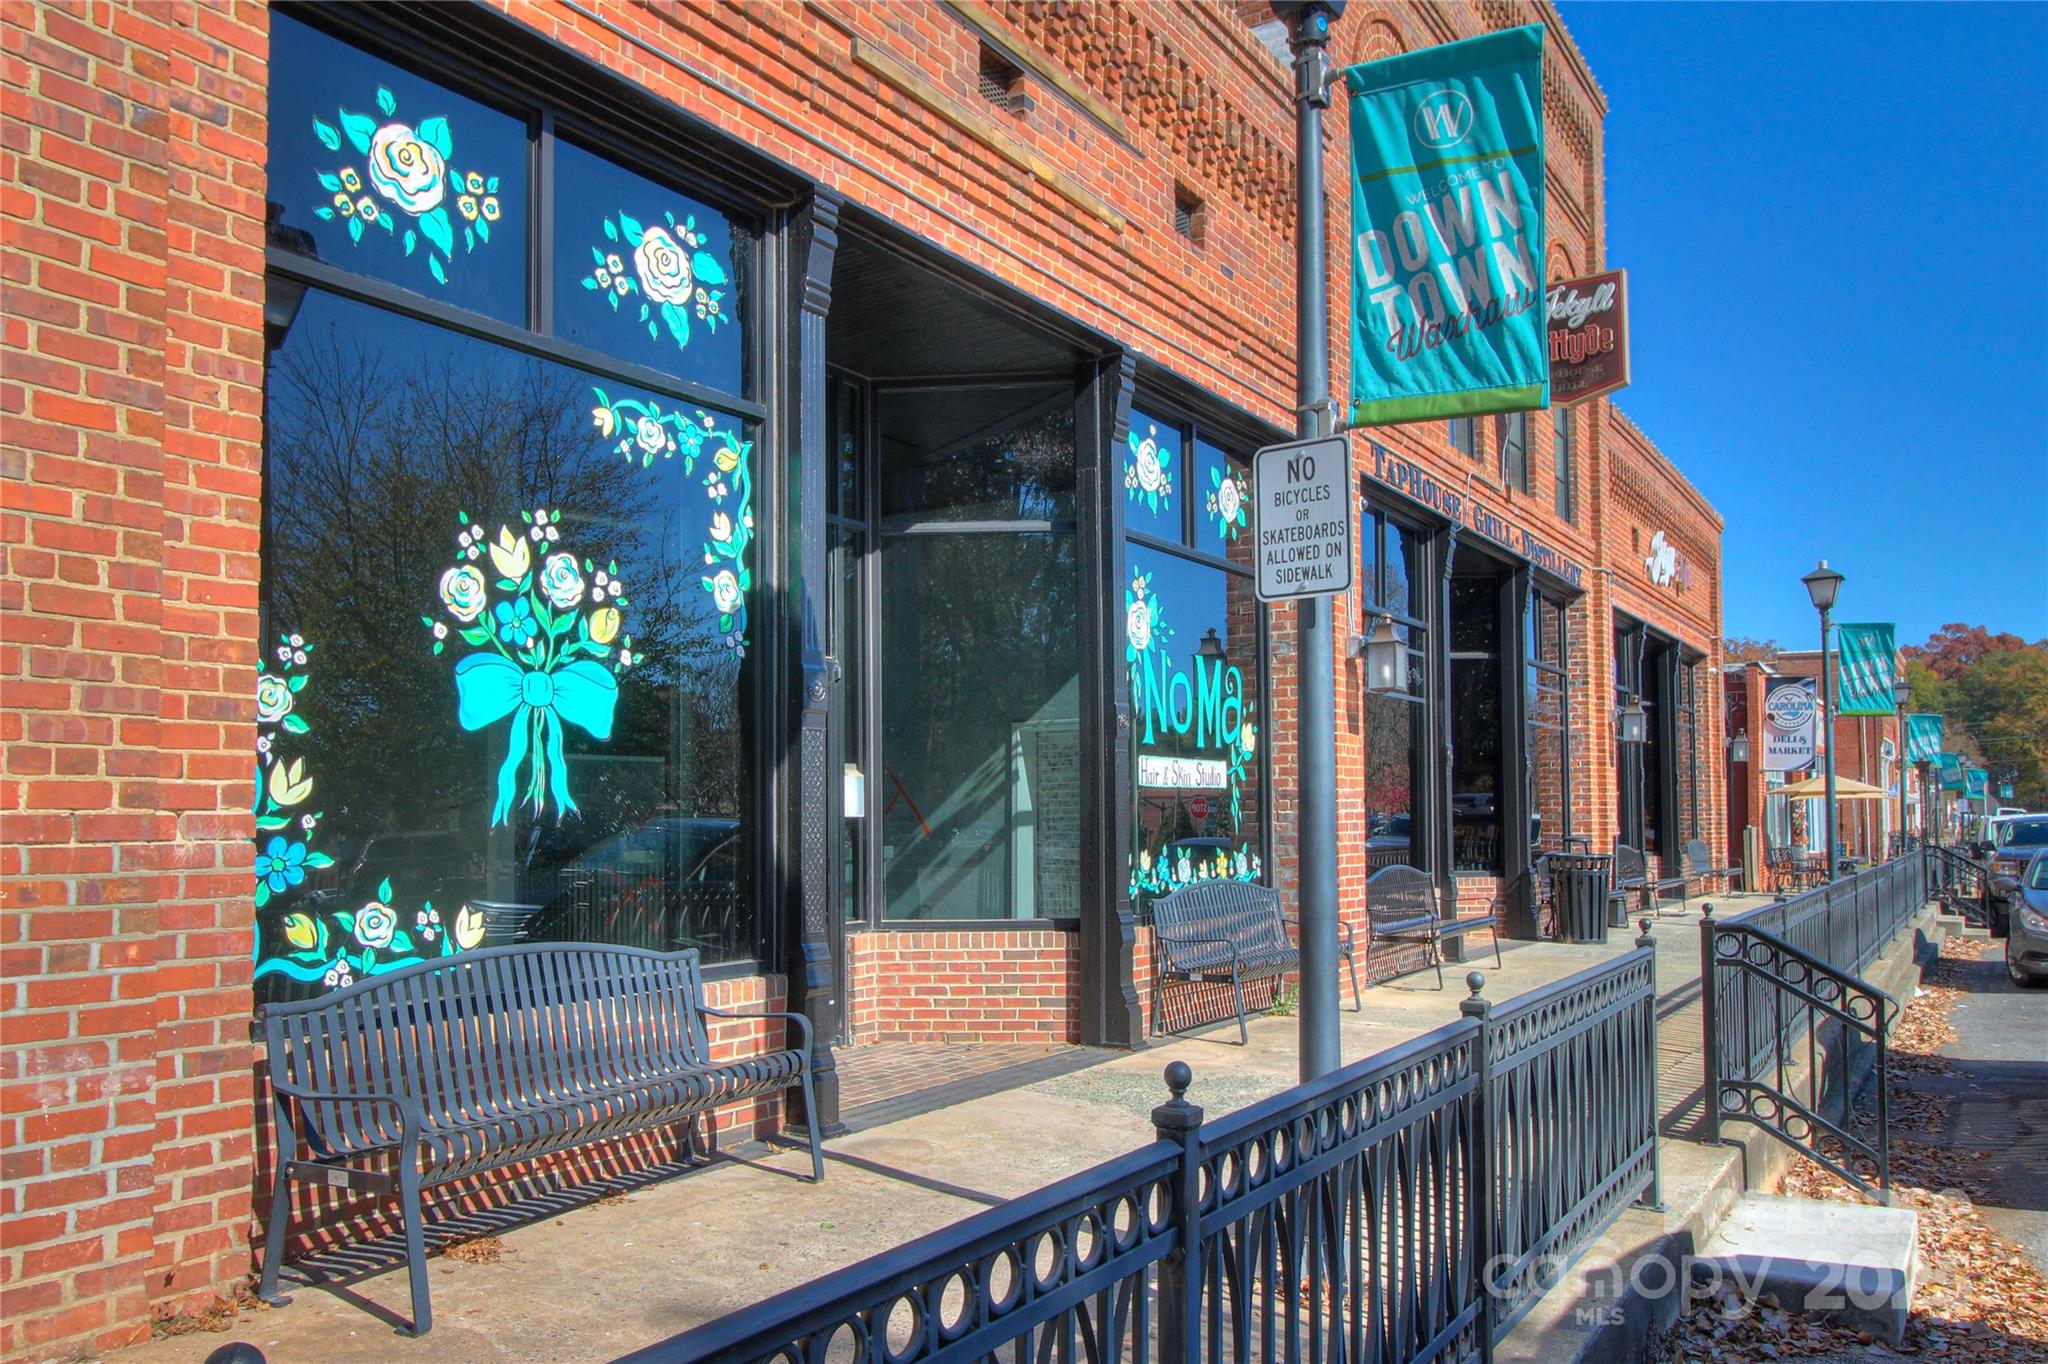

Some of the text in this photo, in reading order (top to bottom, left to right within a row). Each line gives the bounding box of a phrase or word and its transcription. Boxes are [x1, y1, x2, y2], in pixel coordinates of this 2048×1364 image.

[1406, 156, 1505, 205] WELCOME TO
[1358, 171, 1523, 290] DOWN
[1370, 234, 1538, 345] TOWN
[1546, 282, 1616, 328] Jekyll
[1386, 288, 1537, 362] Waxhaw
[1549, 324, 1615, 364] Hyde
[1287, 456, 1316, 484] NO
[1274, 484, 1331, 507] BICYCLES
[1295, 508, 1310, 522] OR
[1473, 505, 1515, 548] GRILL
[1262, 520, 1345, 546] SKATEBOARDS
[1266, 541, 1343, 565] ALLOWED ON
[1275, 563, 1334, 585] SIDEWALK
[1768, 701, 1814, 712] CAROLINA
[1768, 746, 1812, 755] MARKET
[1773, 735, 1797, 744] DELI
[1140, 757, 1160, 785] Hair
[1162, 766, 1169, 786] &
[1195, 762, 1222, 787] Studio
